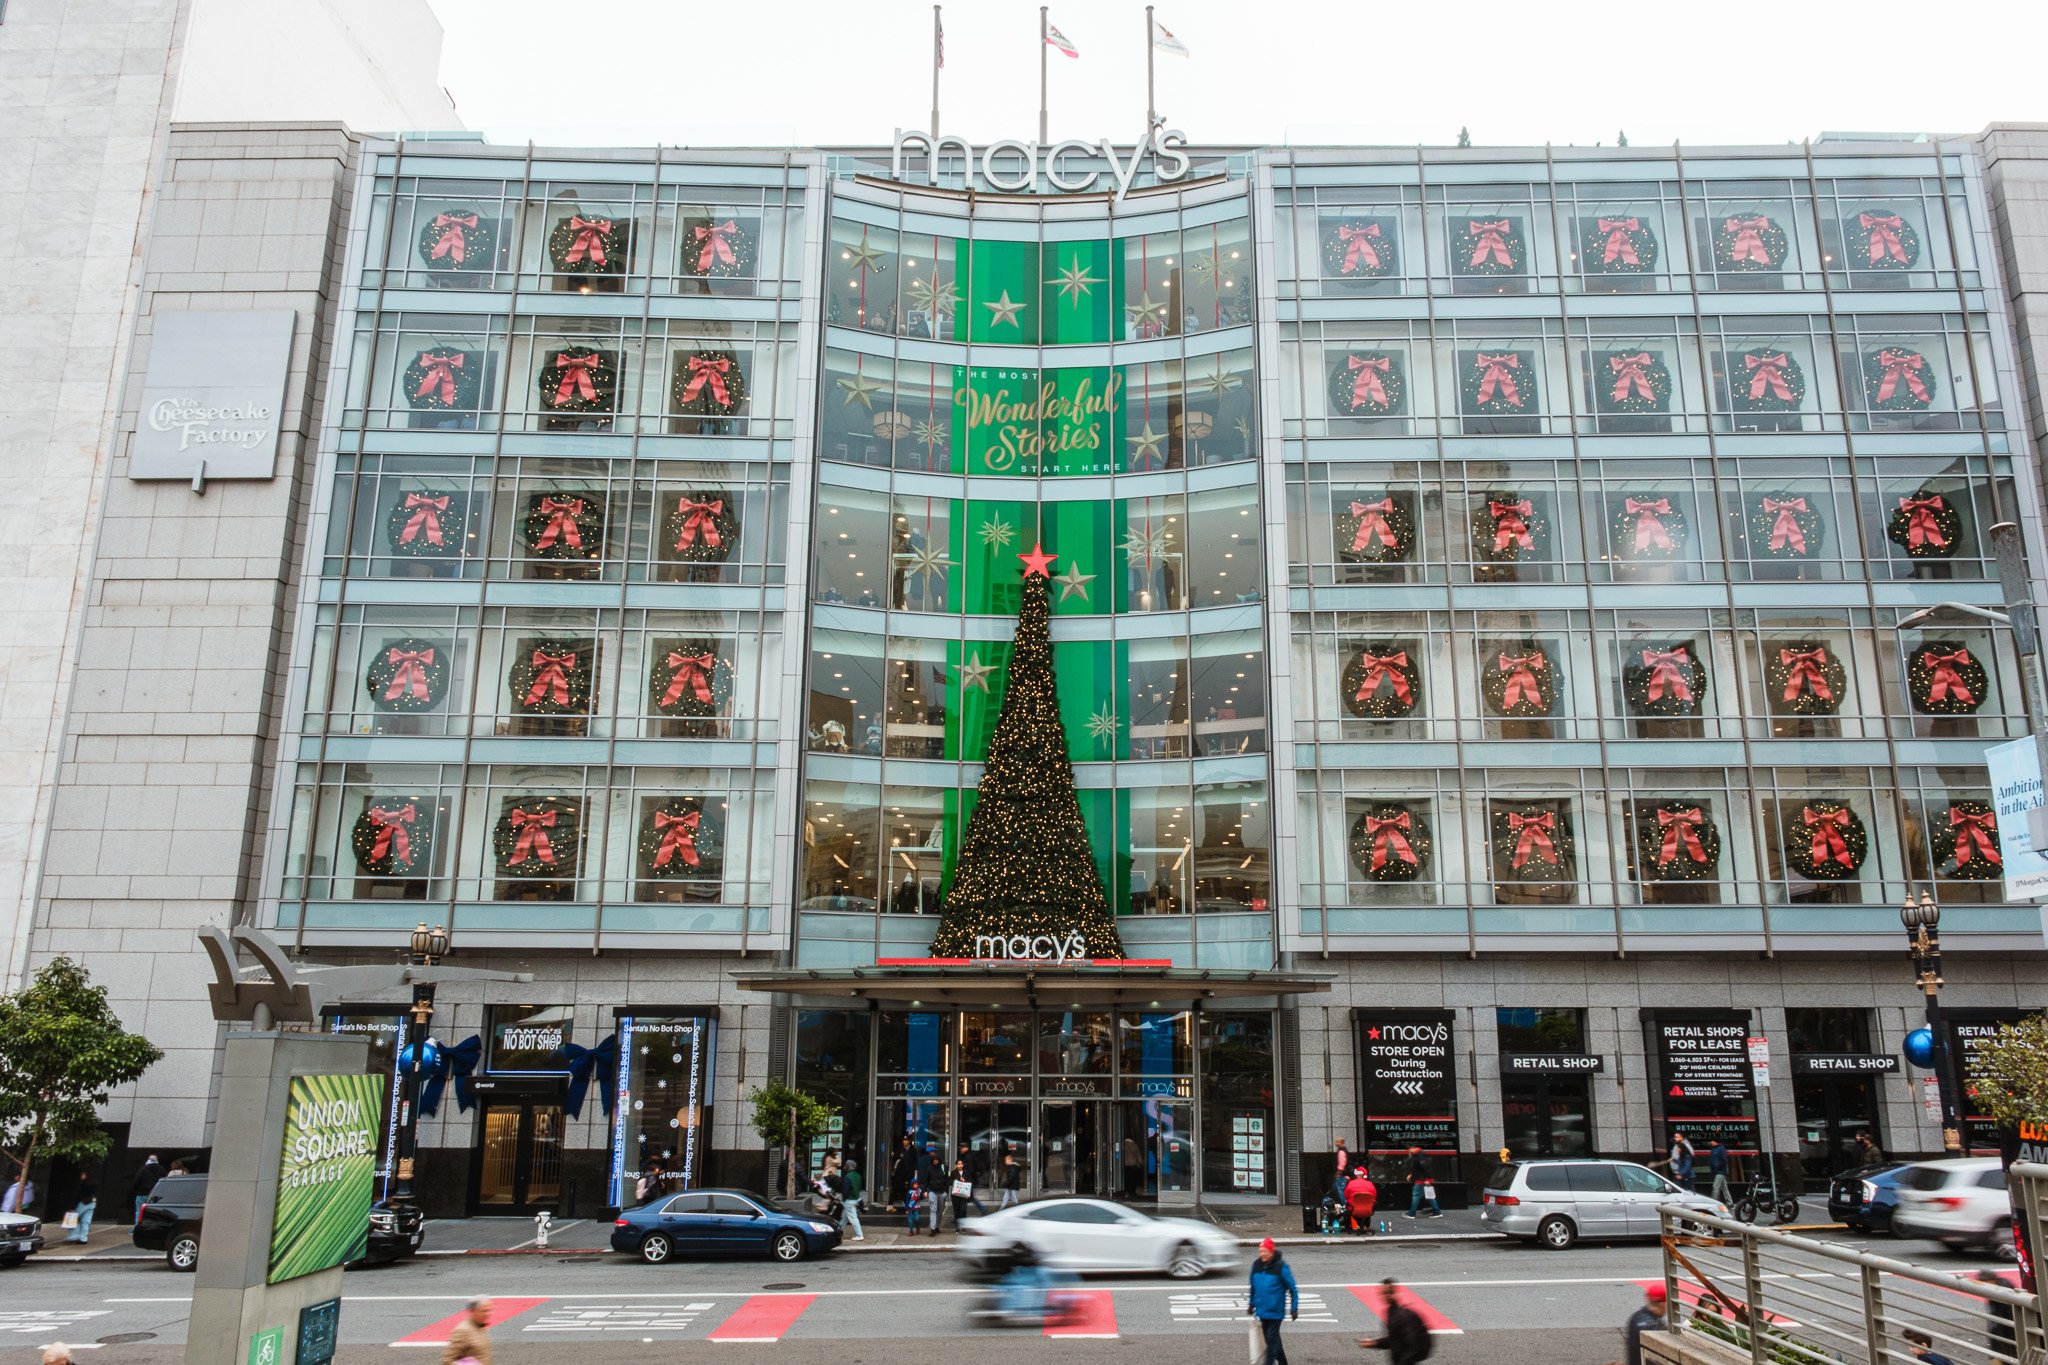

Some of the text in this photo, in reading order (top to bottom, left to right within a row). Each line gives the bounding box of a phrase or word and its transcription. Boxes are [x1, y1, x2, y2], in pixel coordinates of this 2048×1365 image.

[892, 113, 1191, 201] macy's
[957, 368, 1038, 380] THE MOST
[954, 372, 1122, 429] Wonderful
[148, 398, 270, 432] Cheesecake
[173, 420, 269, 453] Factory
[984, 422, 1101, 472] Stories
[1020, 463, 1121, 473] START HERE
[2001, 803, 2011, 816] in
[2013, 799, 2028, 813] the
[976, 930, 1086, 964] macy's
[331, 1023, 399, 1033] Santa's No Bot Shop
[624, 1024, 692, 1034] Santa's No Bot Shop
[1383, 1022, 1448, 1045] macy's
[1664, 1027, 1744, 1037] RETAIL SHOPS
[1957, 1026, 1998, 1036] RETAIL
[503, 1034, 517, 1050] NO
[518, 1034, 536, 1050] BOT
[1669, 1040, 1742, 1049] FOR LEASE
[1371, 1046, 1445, 1056] STORE OPEN
[1391, 1059, 1426, 1069] During
[1513, 1058, 1599, 1068] RETAIL SHOP
[1810, 1059, 1895, 1069] RETAIL SHOP
[1375, 1069, 1443, 1078] Construction
[894, 1079, 933, 1095] macy's
[975, 1079, 1015, 1095] macy's
[1056, 1079, 1095, 1095] macy's
[1137, 1079, 1176, 1095] macy's
[298, 1099, 360, 1131] UNION
[293, 1130, 369, 1164] SQUARE
[291, 1164, 343, 1188] GARAGE
